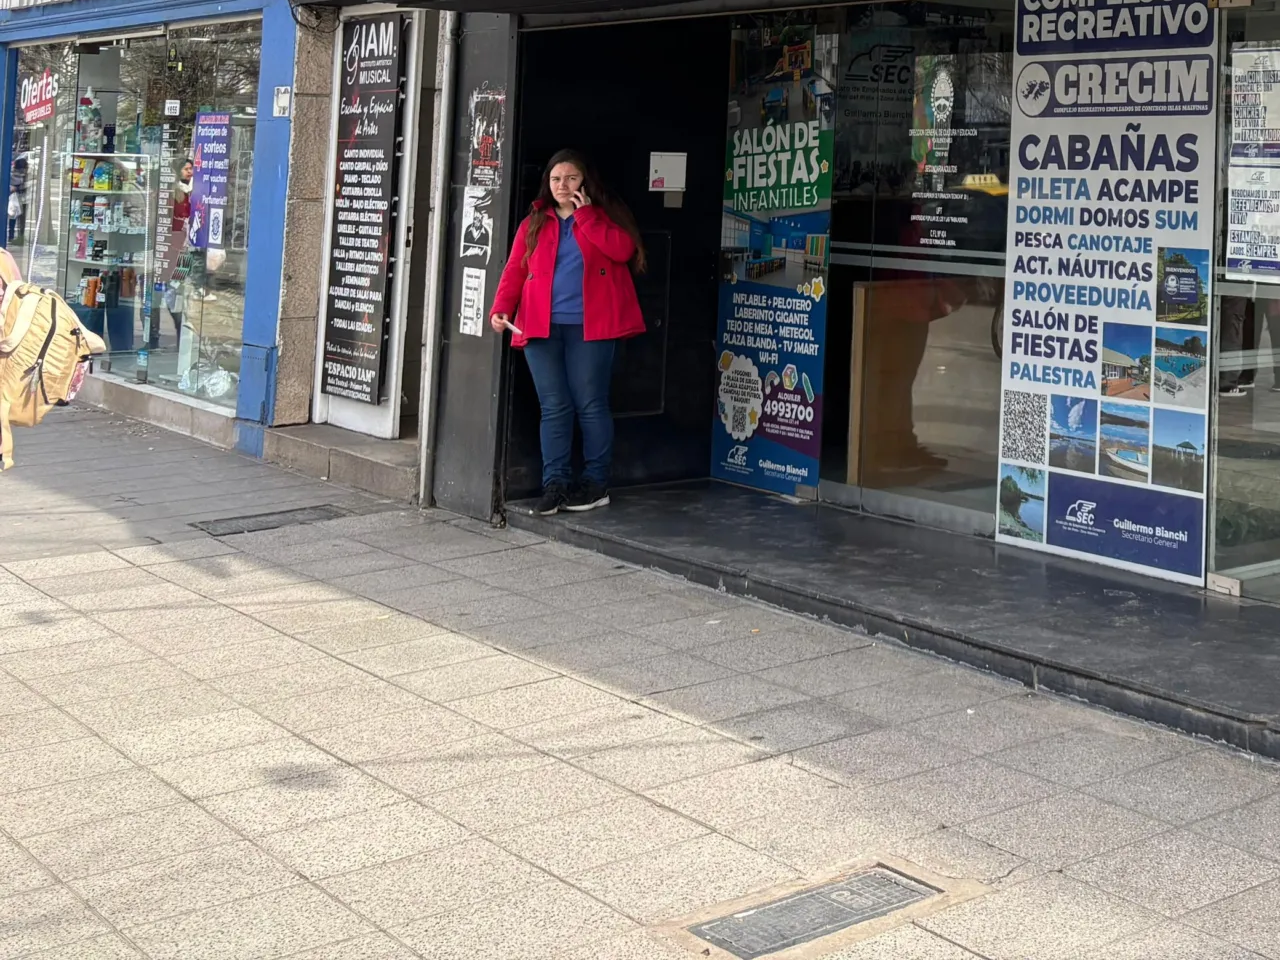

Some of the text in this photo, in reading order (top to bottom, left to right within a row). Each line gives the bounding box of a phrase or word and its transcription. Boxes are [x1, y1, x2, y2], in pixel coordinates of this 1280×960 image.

[1022, 2, 1208, 42] RECREATIVO
[361, 21, 393, 58] IAM
[359, 69, 391, 84] MUSICAL
[1054, 60, 1209, 105] CRECIM
[21, 72, 59, 109] Ofertas
[364, 106, 368, 119] y
[370, 96, 393, 119] Espacio
[221, 128, 227, 136] de
[362, 119, 378, 136] Artes
[733, 118, 819, 156] SALÓN DE
[204, 143, 226, 153] sorteos
[344, 149, 384, 158] CANTO INDIVIDUAL
[1018, 122, 1199, 172] CABAÑAS
[733, 148, 820, 189] FIESTAS
[734, 185, 818, 212] INFANTILES
[1017, 177, 1199, 203] PILETA ACAMPE
[1016, 206, 1198, 230] DORMI DOMOS SUM
[339, 237, 378, 248] TALLER DE TEATRO
[1014, 231, 1152, 254] PESCA CANOTAJE
[1013, 253, 1153, 282] ACT. NÁUTICAS
[733, 293, 766, 306] INFLABLE
[773, 297, 812, 311] PELOTERO
[1013, 281, 1152, 311] PROVEEDURÍA
[735, 307, 809, 325] LABERINTO GIGANTE
[1011, 306, 1098, 334] SALÓN DE
[1011, 332, 1097, 363] FIESTAS
[1010, 362, 1097, 389] PALESTRA
[764, 400, 814, 422] 4993700
[759, 460, 785, 472] Guillermo
[786, 465, 808, 476] Bianchi
[1076, 510, 1095, 526] SEC
[1113, 518, 1153, 535] Guillermo
[1156, 526, 1187, 542] Bianchi
[1121, 530, 1179, 549] Secretario General
